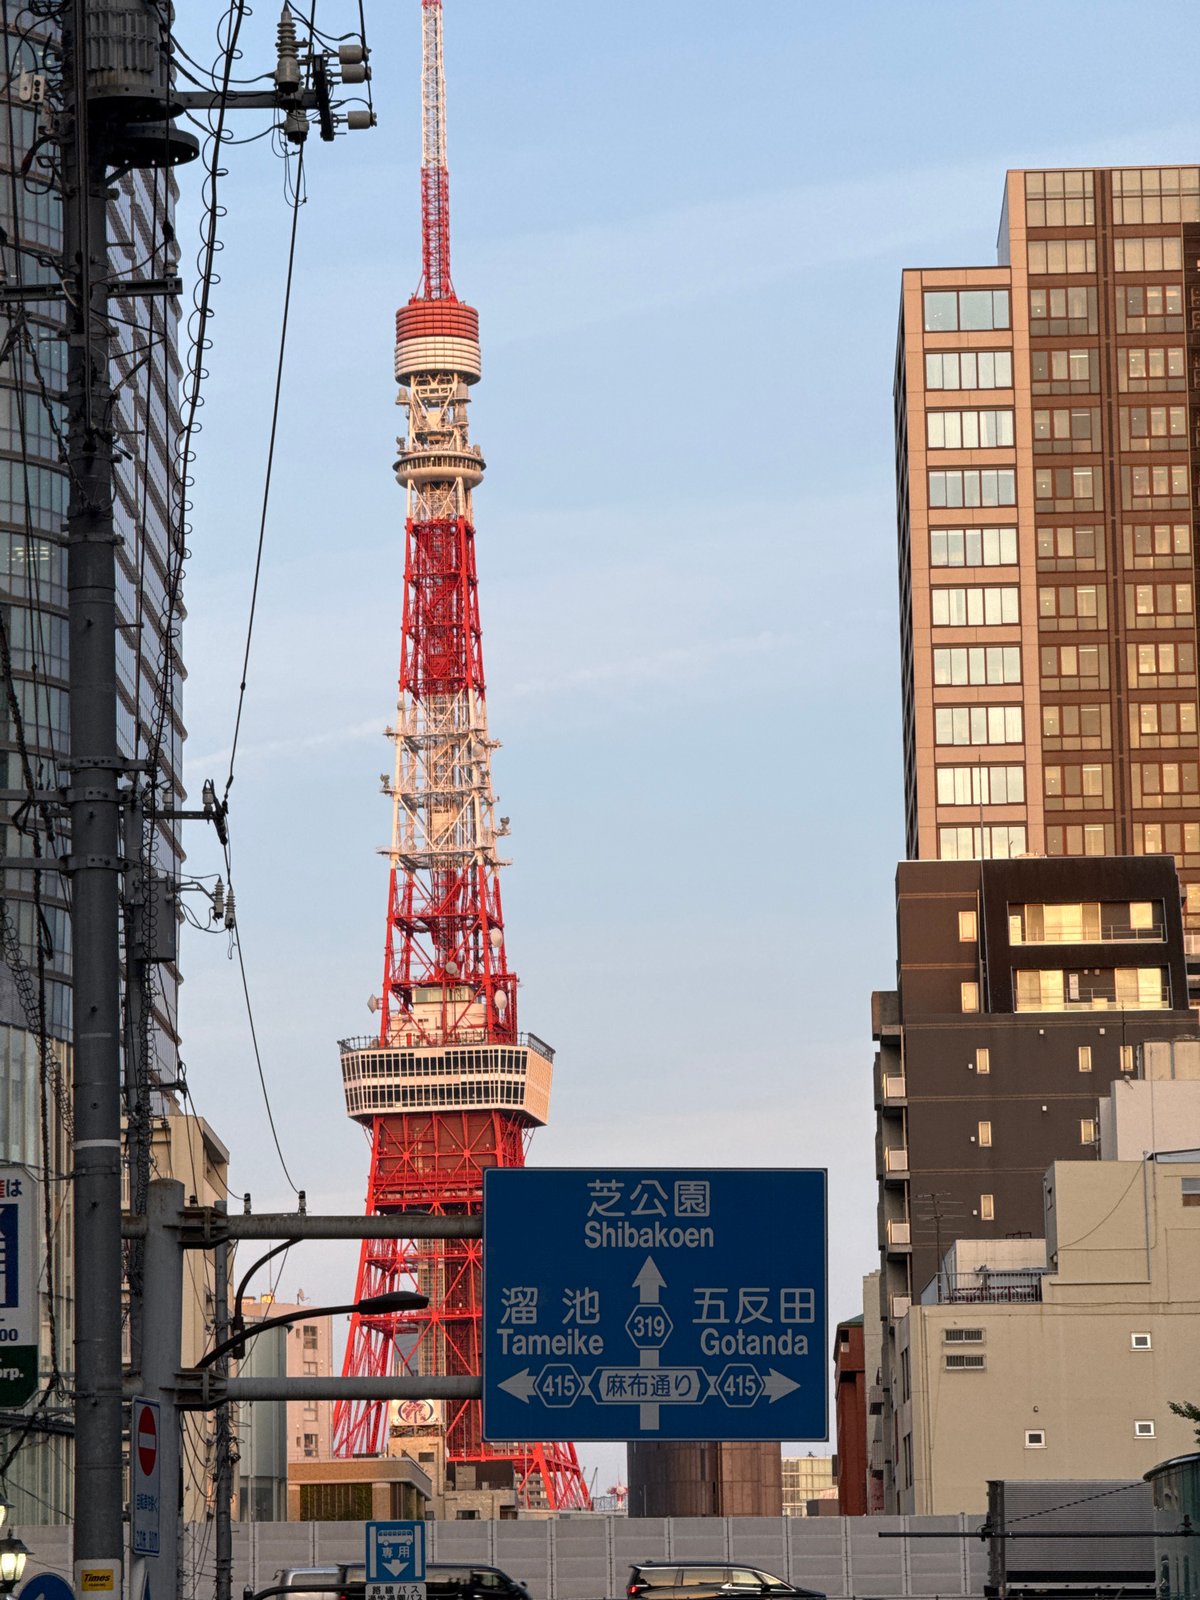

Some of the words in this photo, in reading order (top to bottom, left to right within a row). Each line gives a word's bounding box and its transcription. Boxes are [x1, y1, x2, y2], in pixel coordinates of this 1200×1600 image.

[587, 1179, 710, 1217] 芝公園
[585, 1221, 714, 1248] Shibakoen
[501, 1286, 600, 1324] 溜池
[692, 1288, 815, 1323] 五反田
[634, 1315, 665, 1337] 319
[497, 1329, 604, 1355] Tameike
[701, 1328, 809, 1355] Gotanda
[542, 1375, 575, 1396] 415
[606, 1373, 692, 1397] 麻布通り
[724, 1375, 756, 1396] 415
[381, 1546, 410, 1558] 専用
[84, 1573, 111, 1582] Times
[372, 1585, 420, 1595] 路線バス
